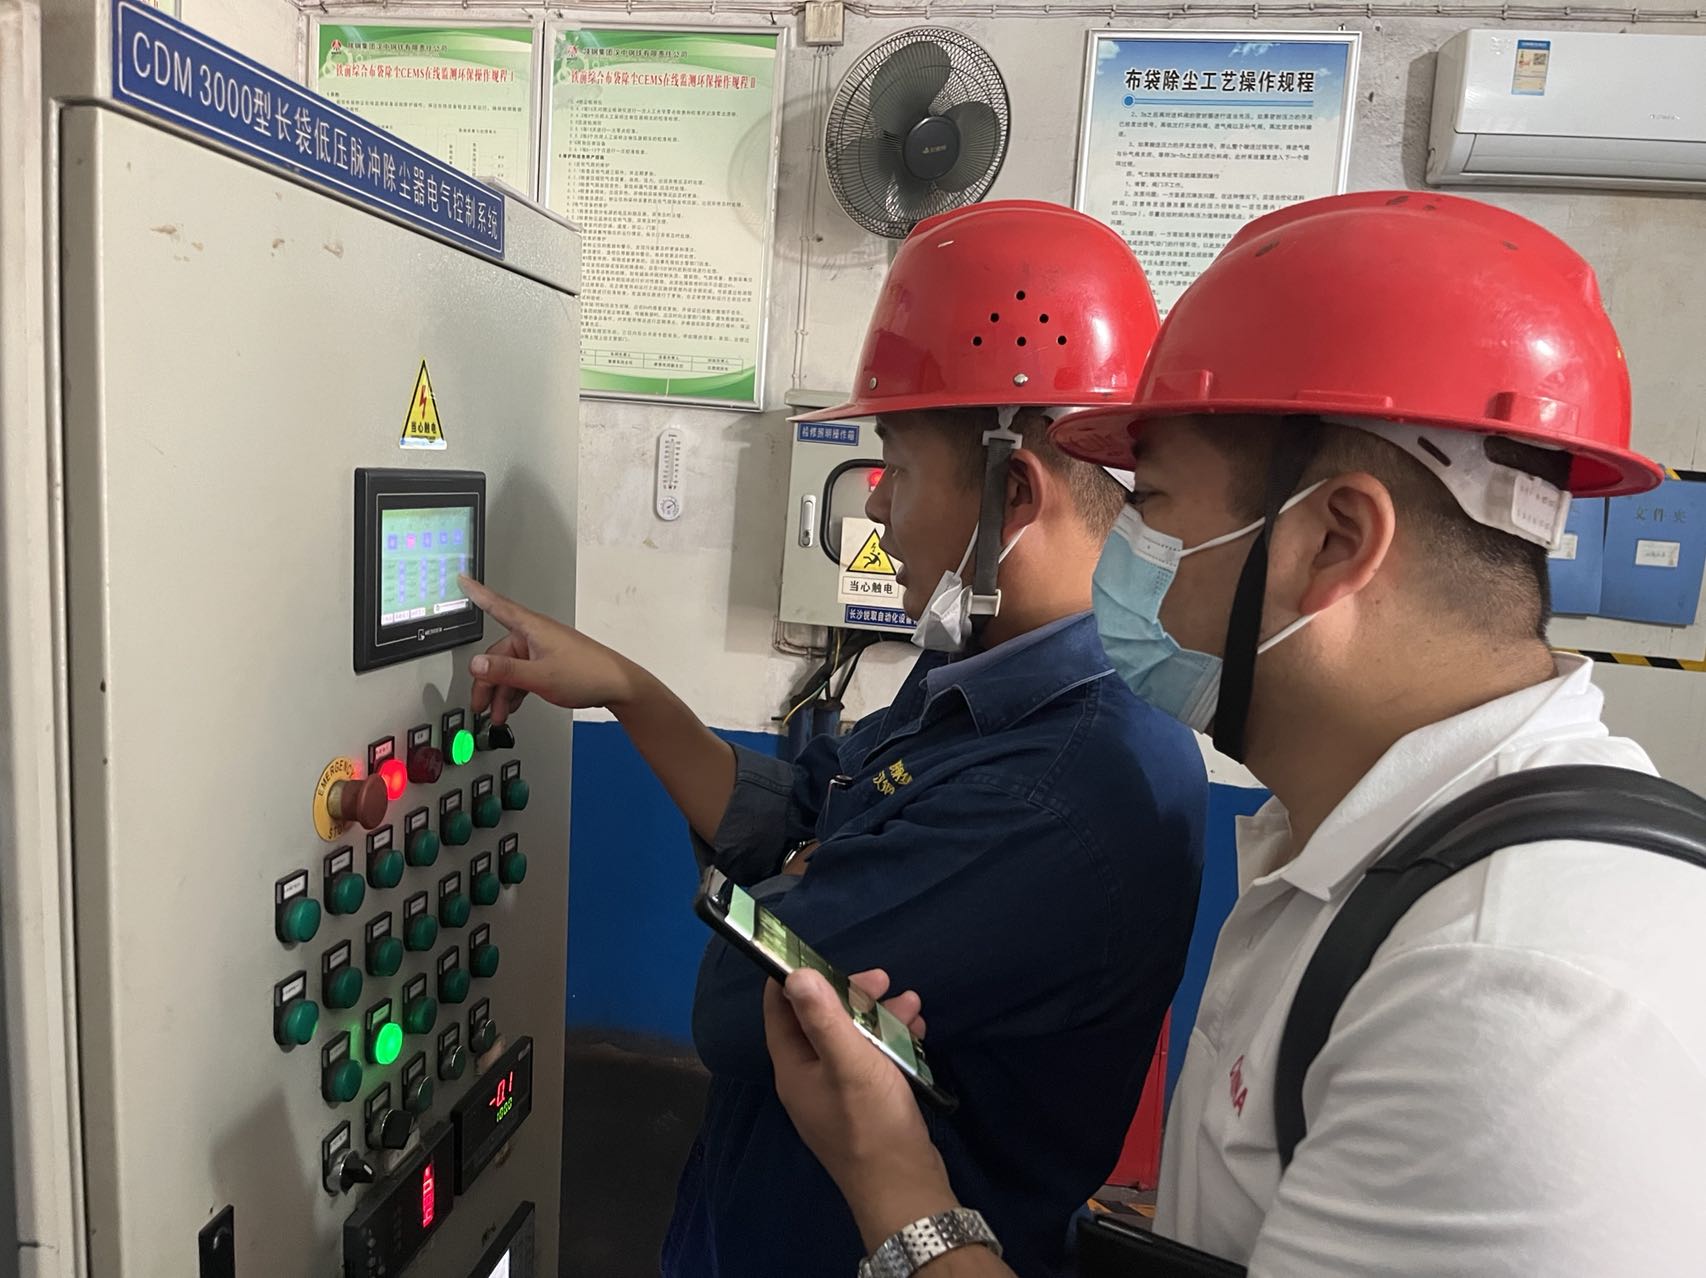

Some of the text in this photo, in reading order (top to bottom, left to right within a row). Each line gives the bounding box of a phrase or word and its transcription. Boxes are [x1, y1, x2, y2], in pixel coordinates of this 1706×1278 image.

[1125, 69, 1315, 94] 布袋除尘工艺操作规程
[133, 31, 192, 98] CDM
[200, 64, 499, 241] 3000型长袋低压脉冲除尘器电气控制系统
[411, 421, 437, 434] 当心触电
[849, 580, 893, 595] 当心触电
